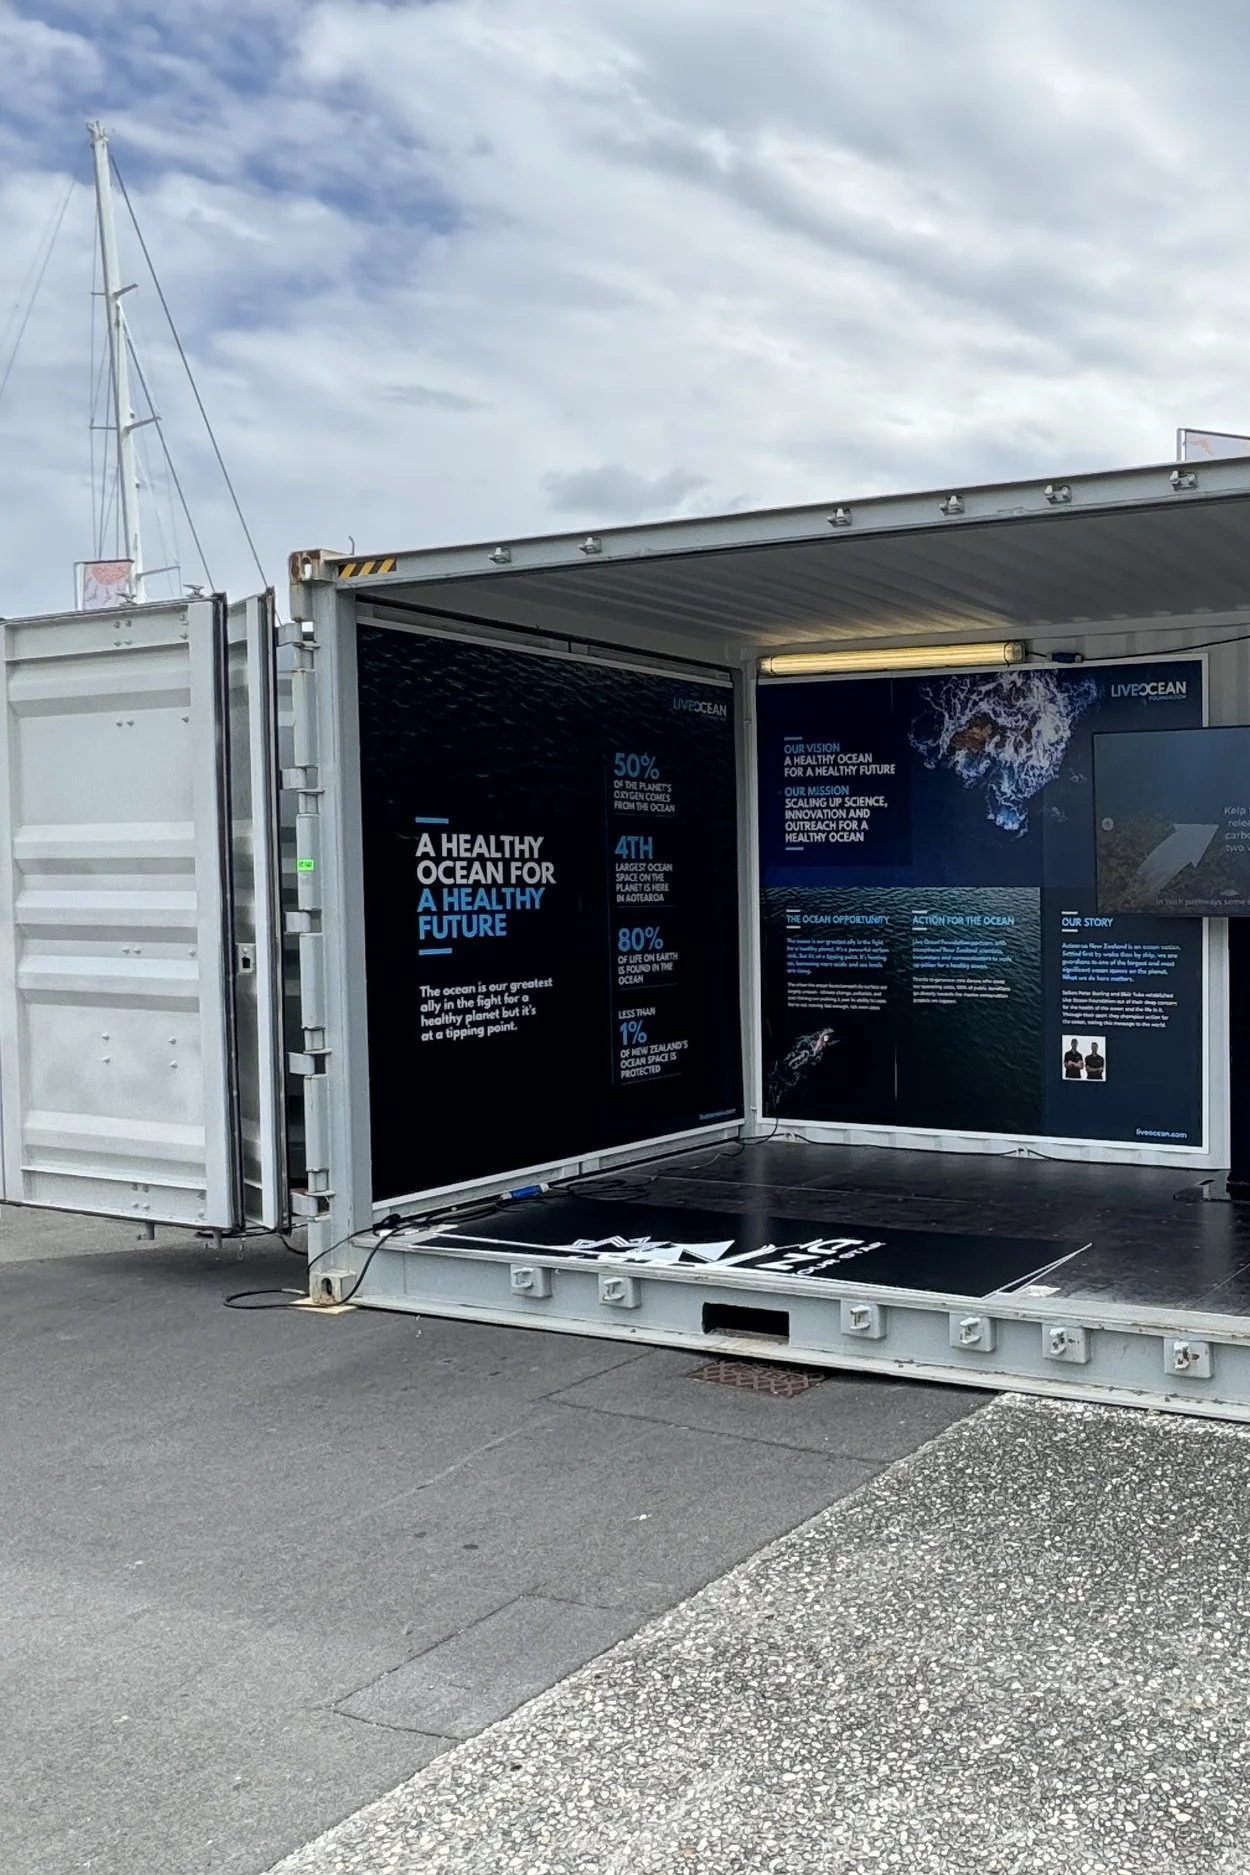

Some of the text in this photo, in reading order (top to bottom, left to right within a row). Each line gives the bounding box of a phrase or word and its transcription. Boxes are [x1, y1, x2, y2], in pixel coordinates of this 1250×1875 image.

[1111, 681, 1187, 698] LIVEOCEAN
[673, 696, 727, 717] LIVEOCEAN
[784, 742, 840, 754] OUR VISION
[784, 752, 873, 766] A HEALTHY OCEAN
[614, 752, 660, 780] 50%
[784, 764, 896, 777] FOR A HEALTHY FUTURE
[614, 780, 624, 789] OF
[625, 781, 638, 790] THE
[784, 785, 850, 797] OUR MISSION
[614, 791, 671, 802] OXYGEN COMES
[785, 796, 888, 808] SCALING UP SCIENCE,
[614, 801, 675, 813] FROM THE OCEAN
[1224, 806, 1246, 816] Kelp
[785, 808, 870, 820] INNOVATION AND
[785, 820, 869, 831] OUTREACH FOR A
[785, 831, 864, 843] HEALTHY OCEAN
[415, 832, 545, 859] A HEALTHY
[615, 835, 653, 860] 4TH
[1225, 844, 1245, 852] two
[416, 860, 557, 885] OCEAN FOR
[615, 863, 673, 872] LARGEST OCEAN
[615, 873, 664, 882] SPACE ON THE
[616, 883, 669, 893] PLANET IS HERE
[417, 887, 546, 913] A HEALTHY
[616, 893, 625, 903] IN
[1184, 898, 1222, 907] pathways
[786, 915, 890, 924] THE OCEAN OPPORTUNITY
[913, 915, 1015, 925] ACTION FOR THE OCEAN
[1061, 917, 1114, 928] OUR STORY
[418, 913, 507, 940] FUTURE
[617, 926, 664, 952] 80%
[618, 952, 679, 965] OF LIFE ON EARTH
[618, 962, 673, 974] IS FOUND IN THE
[618, 975, 644, 985] OCEAN
[419, 977, 553, 998] The ocean is our greatest
[420, 993, 530, 1015] ally in the fight for a
[420, 1004, 537, 1028] healthy planet but it's
[618, 1007, 656, 1019] LESS THAN
[421, 1020, 518, 1042] at a tipping point.
[619, 1020, 647, 1046] 1%
[620, 1049, 630, 1058] OF
[631, 1046, 649, 1057] NEW
[620, 1052, 677, 1069] OCEAN SPACE IS
[620, 1064, 661, 1078] PROTECTED
